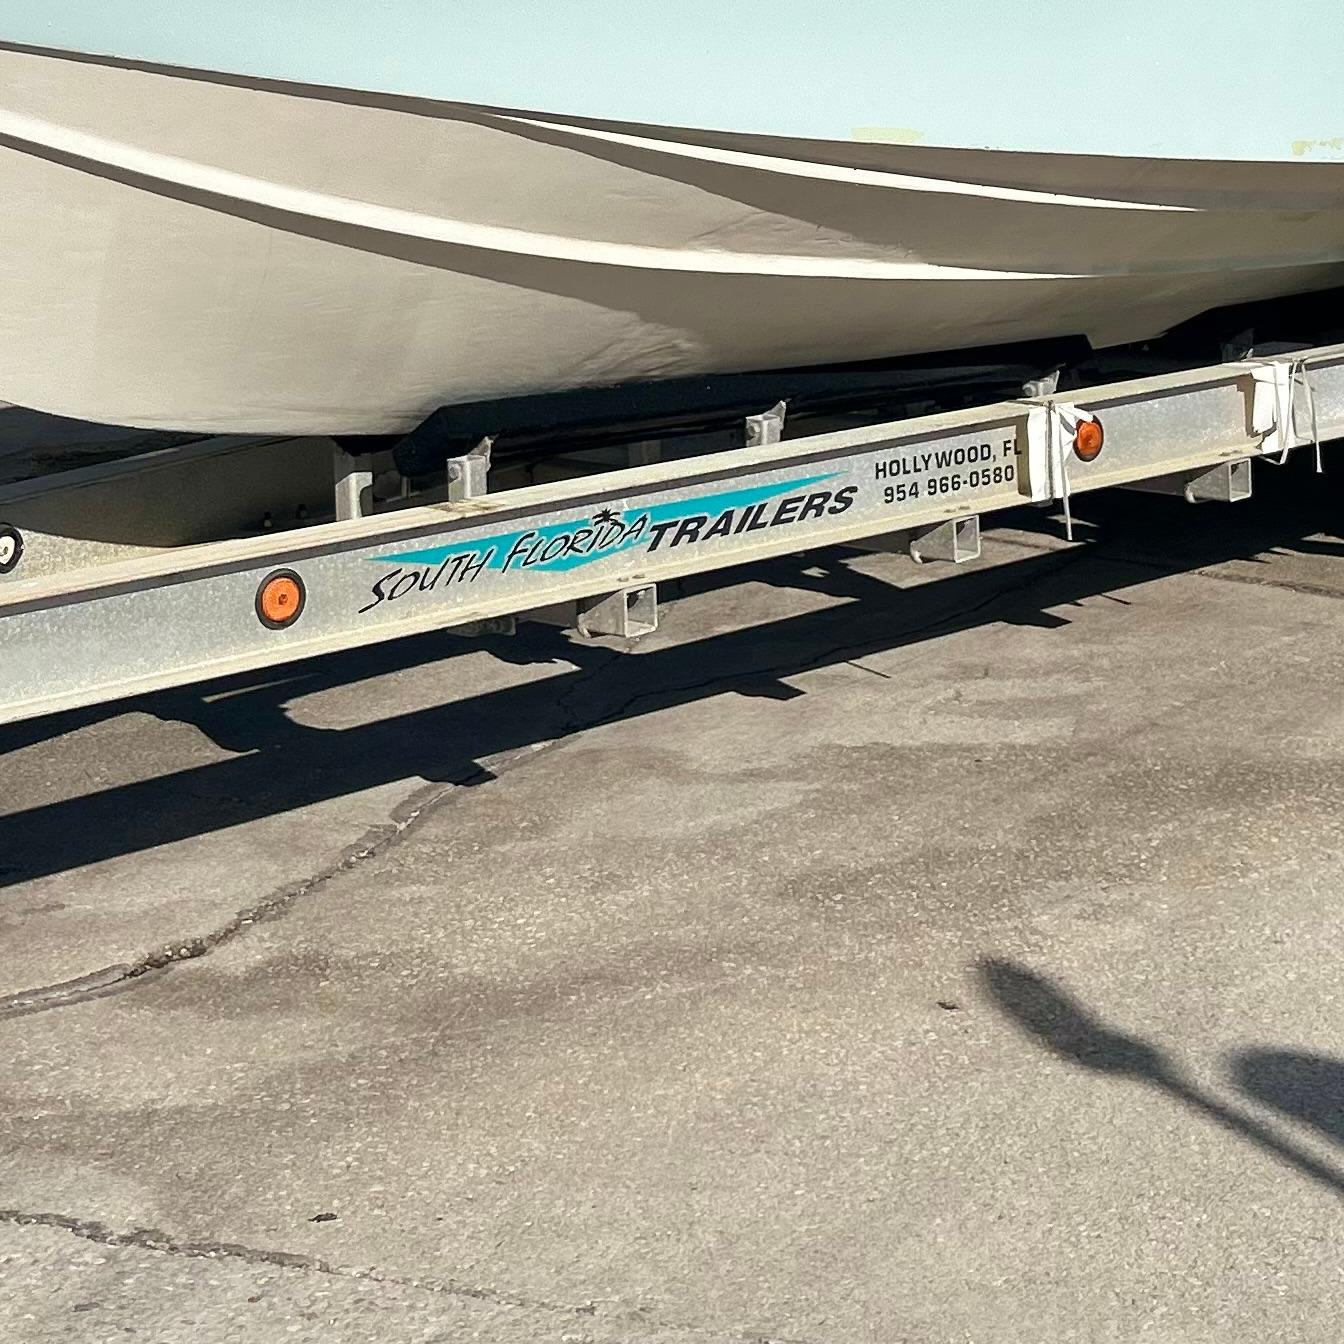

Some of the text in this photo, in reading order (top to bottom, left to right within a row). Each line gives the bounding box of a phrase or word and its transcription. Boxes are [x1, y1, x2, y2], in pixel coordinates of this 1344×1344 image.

[875, 438, 1023, 480] HOLLYWOOD, FL
[884, 464, 1016, 504] 954 966-0580
[358, 485, 859, 613] SOUTH FLORIDA TRAILERS
